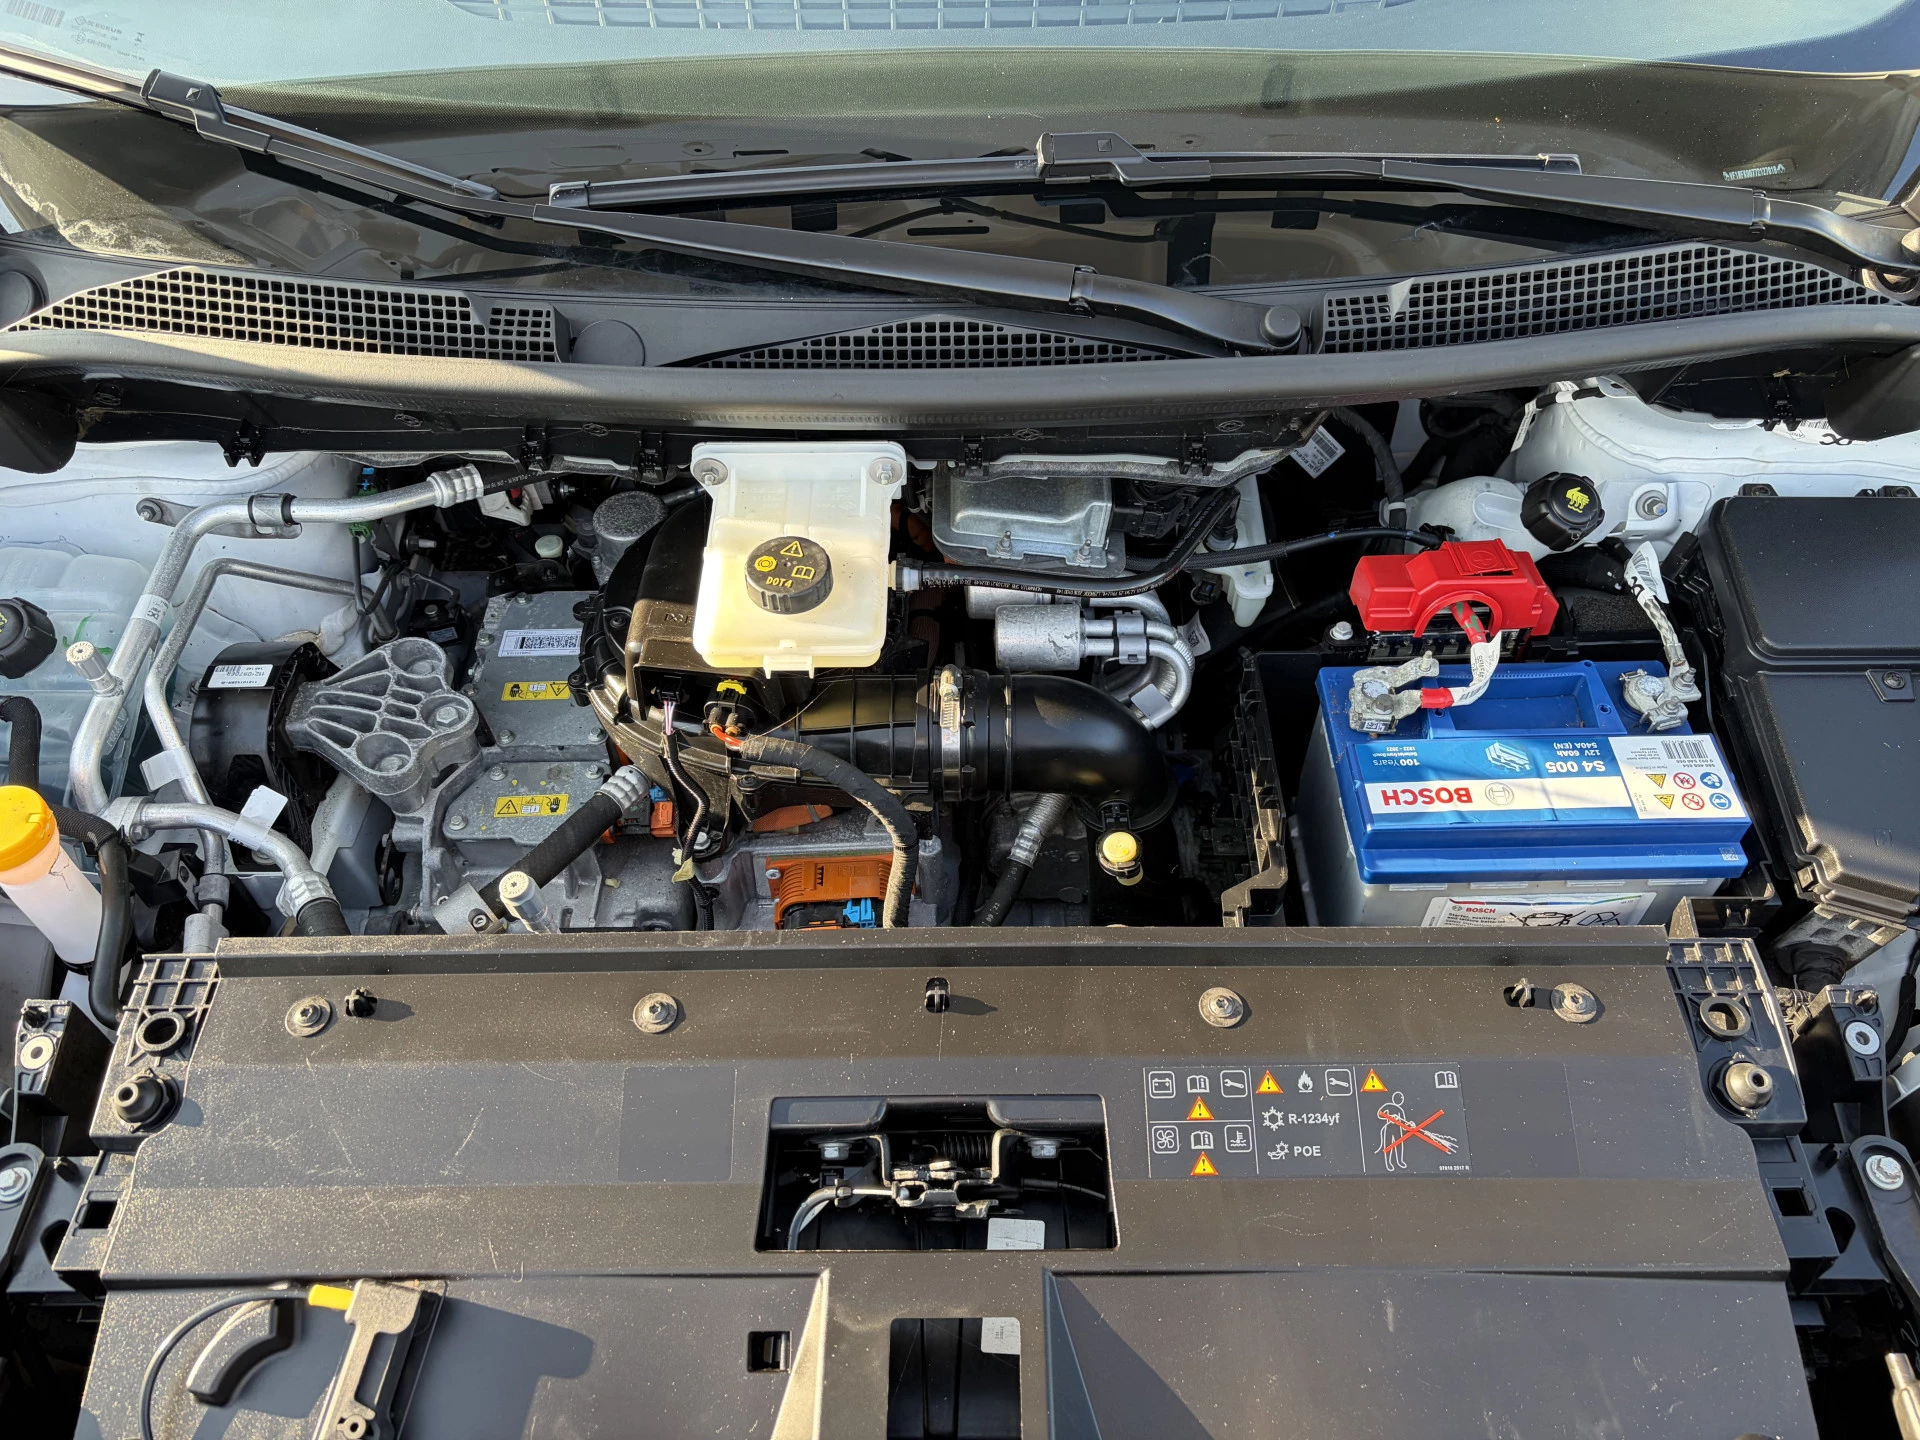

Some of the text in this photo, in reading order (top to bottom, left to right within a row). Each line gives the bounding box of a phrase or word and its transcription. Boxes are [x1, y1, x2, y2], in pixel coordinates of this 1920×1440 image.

[1553, 742, 1573, 750] (EN)
[1556, 749, 1580, 757] 60Ah
[1544, 760, 1606, 773] S4 005
[1380, 787, 1473, 806] BOSCH
[1288, 1111, 1340, 1126] R-1234yf
[1293, 1145, 1321, 1157] POE
